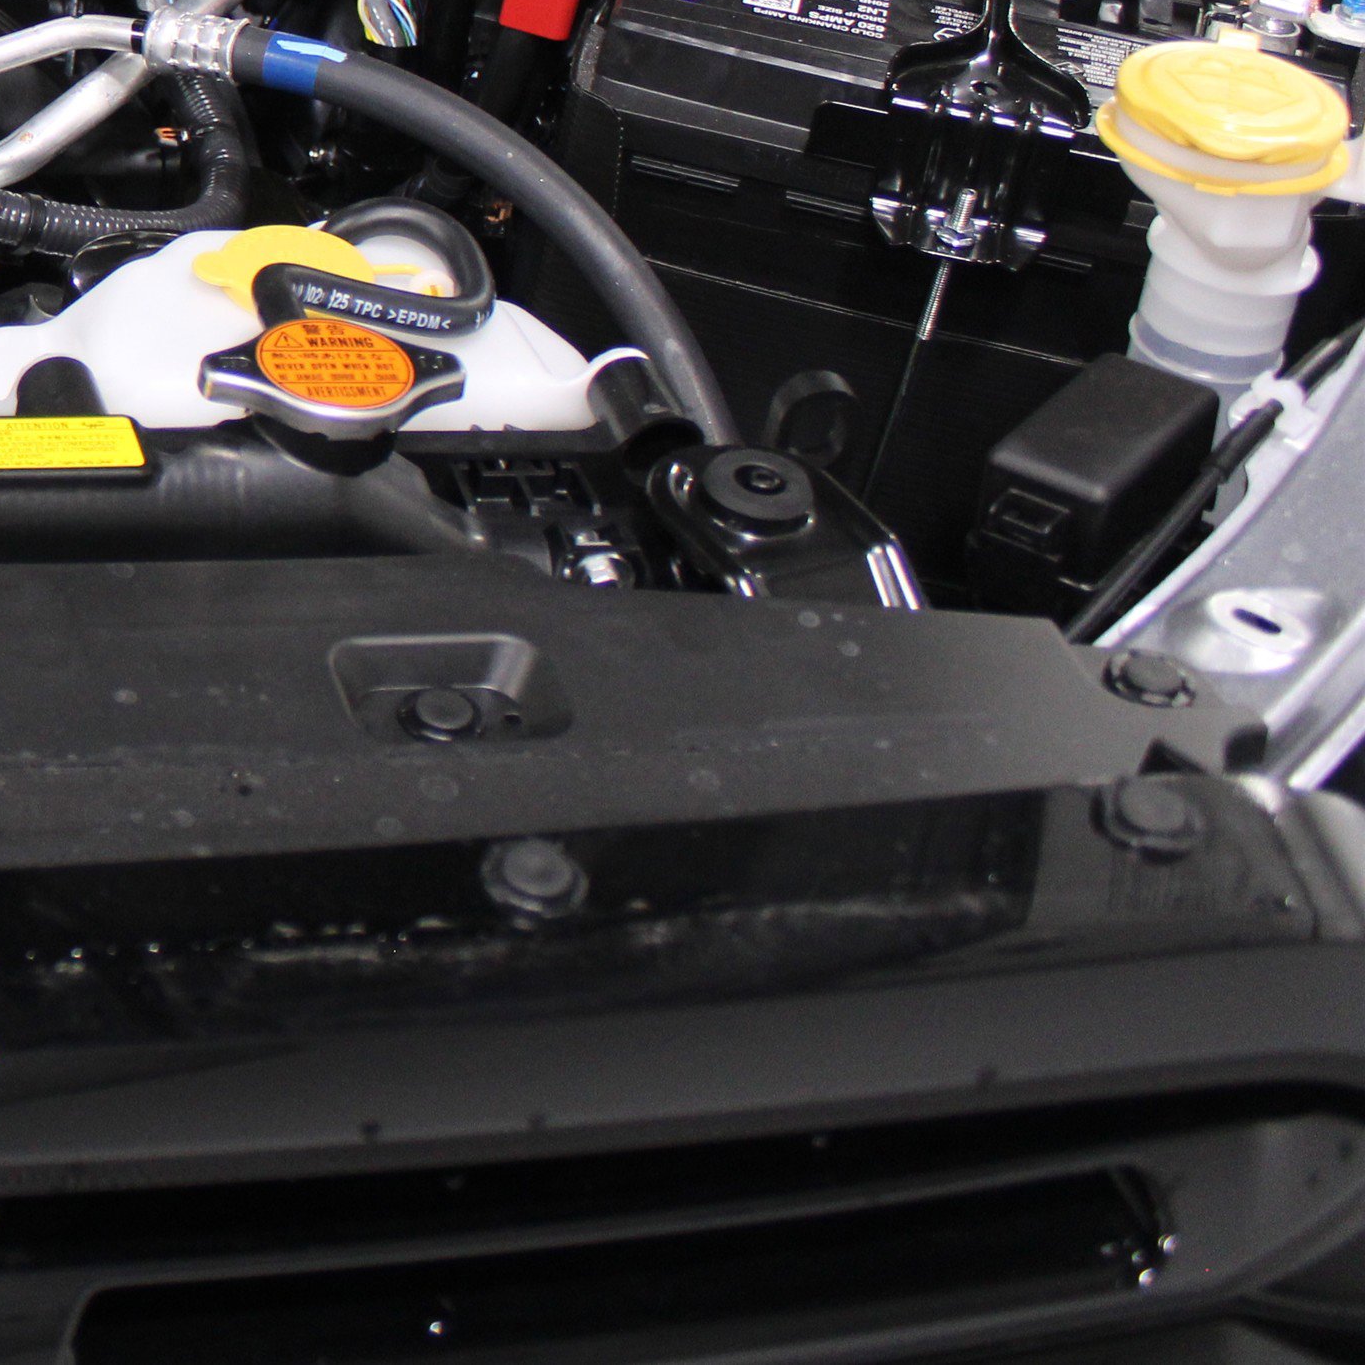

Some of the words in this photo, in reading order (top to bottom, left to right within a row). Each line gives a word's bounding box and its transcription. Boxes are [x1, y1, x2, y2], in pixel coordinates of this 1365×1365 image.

[753, 6, 785, 18] AMPS
[817, 4, 843, 15] SIZE
[857, 4, 888, 16] LN2
[808, 11, 856, 27] AMPS
[845, 10, 887, 23] GROUP
[788, 14, 849, 32] CRANKING
[858, 21, 886, 32] 620
[850, 26, 884, 39] COLD
[353, 299, 384, 318] TPC
[306, 337, 375, 348] WARNING
[7, 422, 69, 431] ATTENTION
